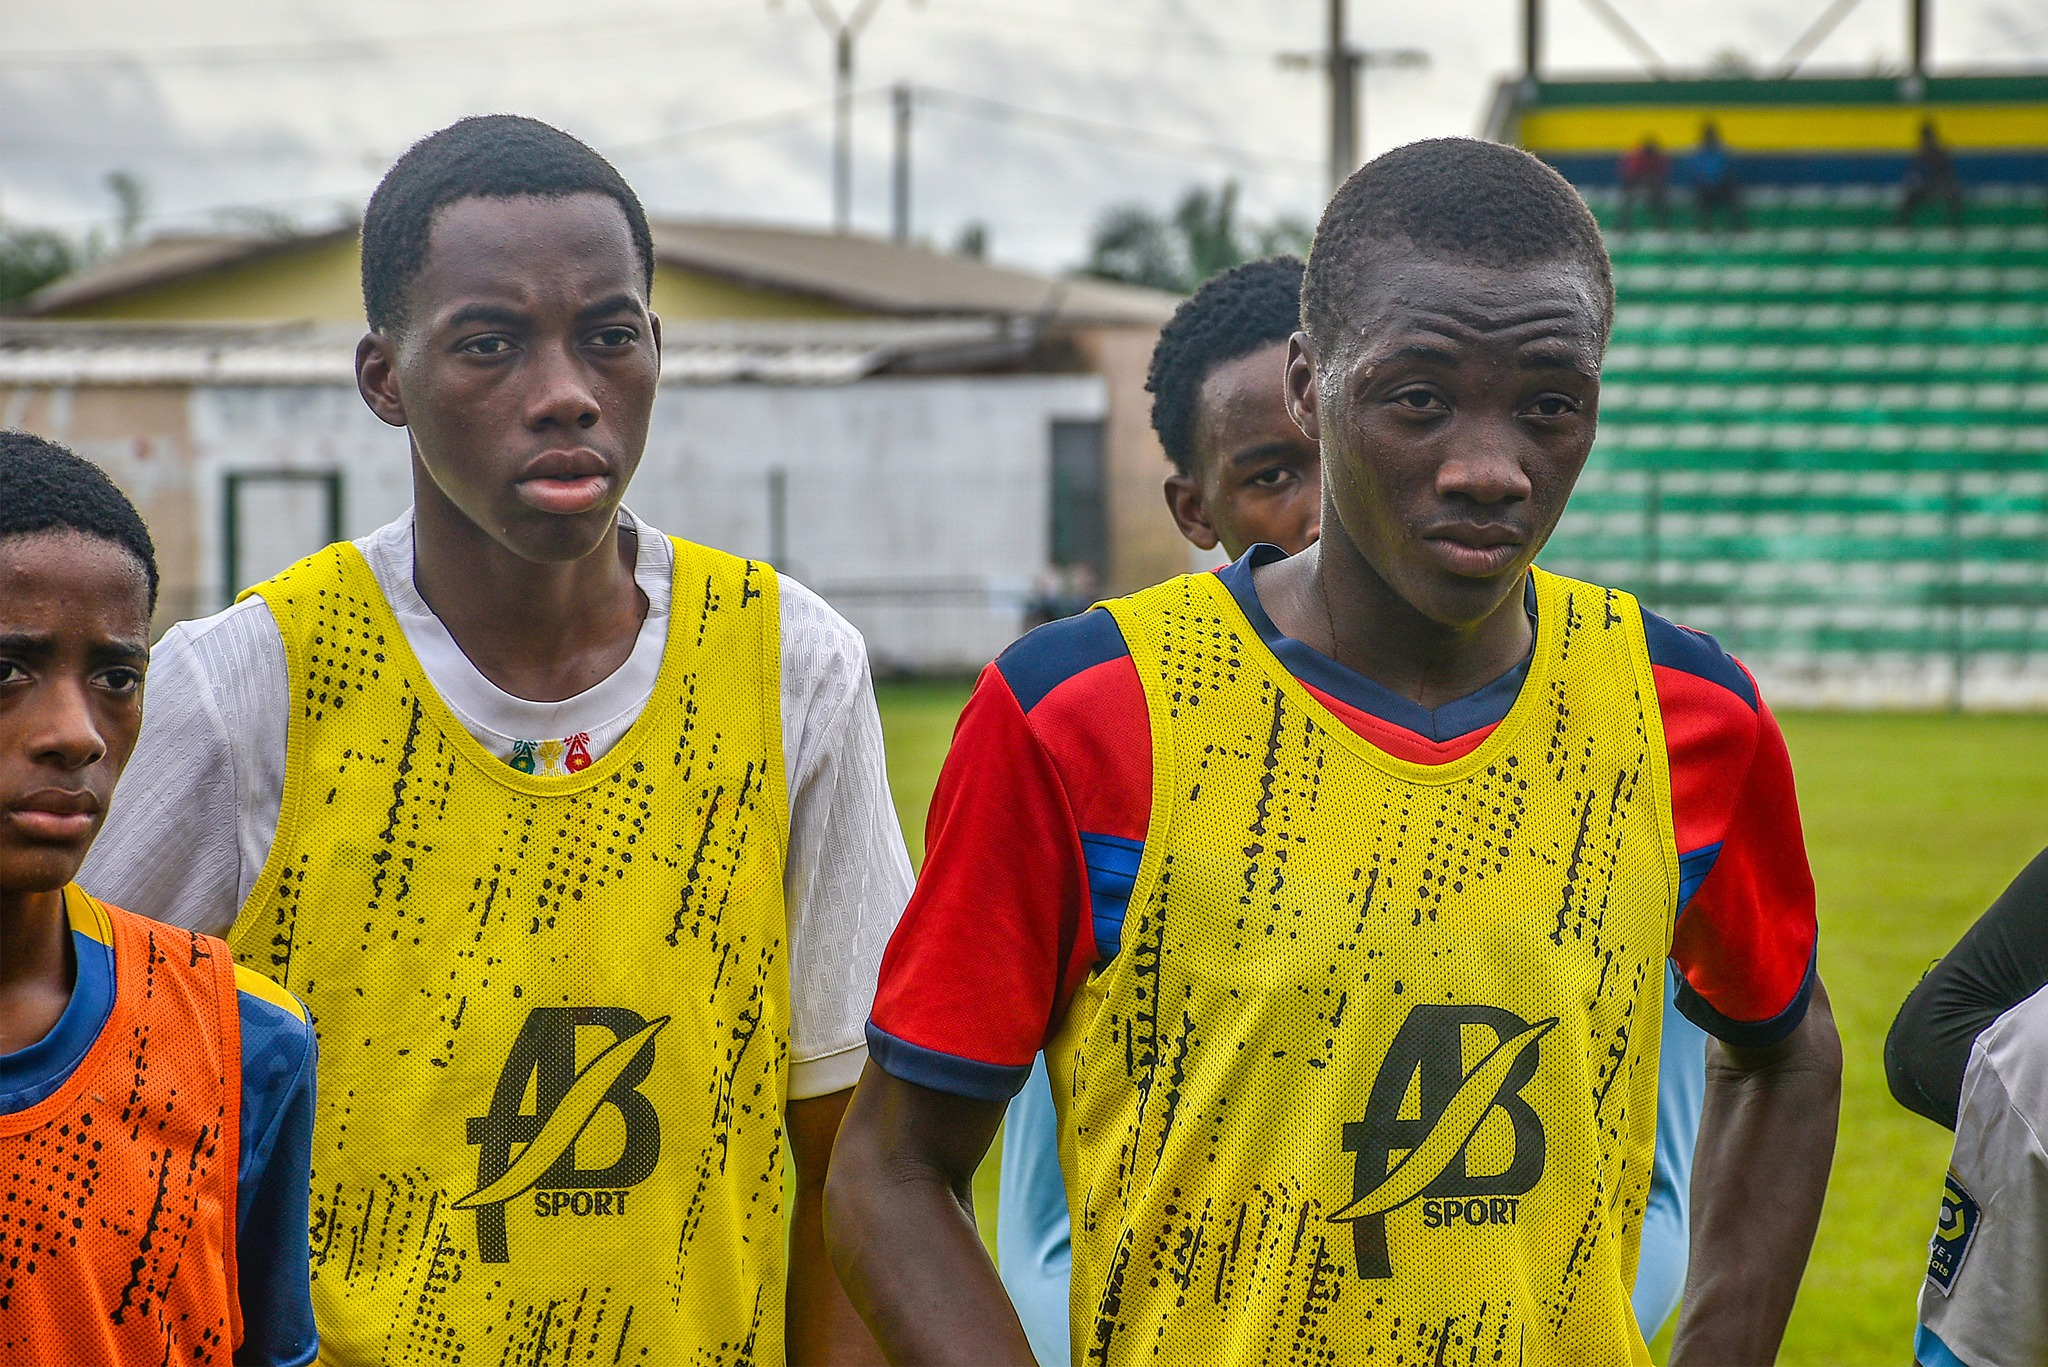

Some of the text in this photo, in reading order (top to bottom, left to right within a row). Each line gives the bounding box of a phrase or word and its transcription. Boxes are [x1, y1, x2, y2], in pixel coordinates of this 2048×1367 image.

[465, 1006, 662, 1264] AB
[1341, 1003, 1546, 1280] AB
[534, 1190, 630, 1218] SPORT
[1422, 1198, 1520, 1229] SPORT
[1930, 1256, 1949, 1277] ats
